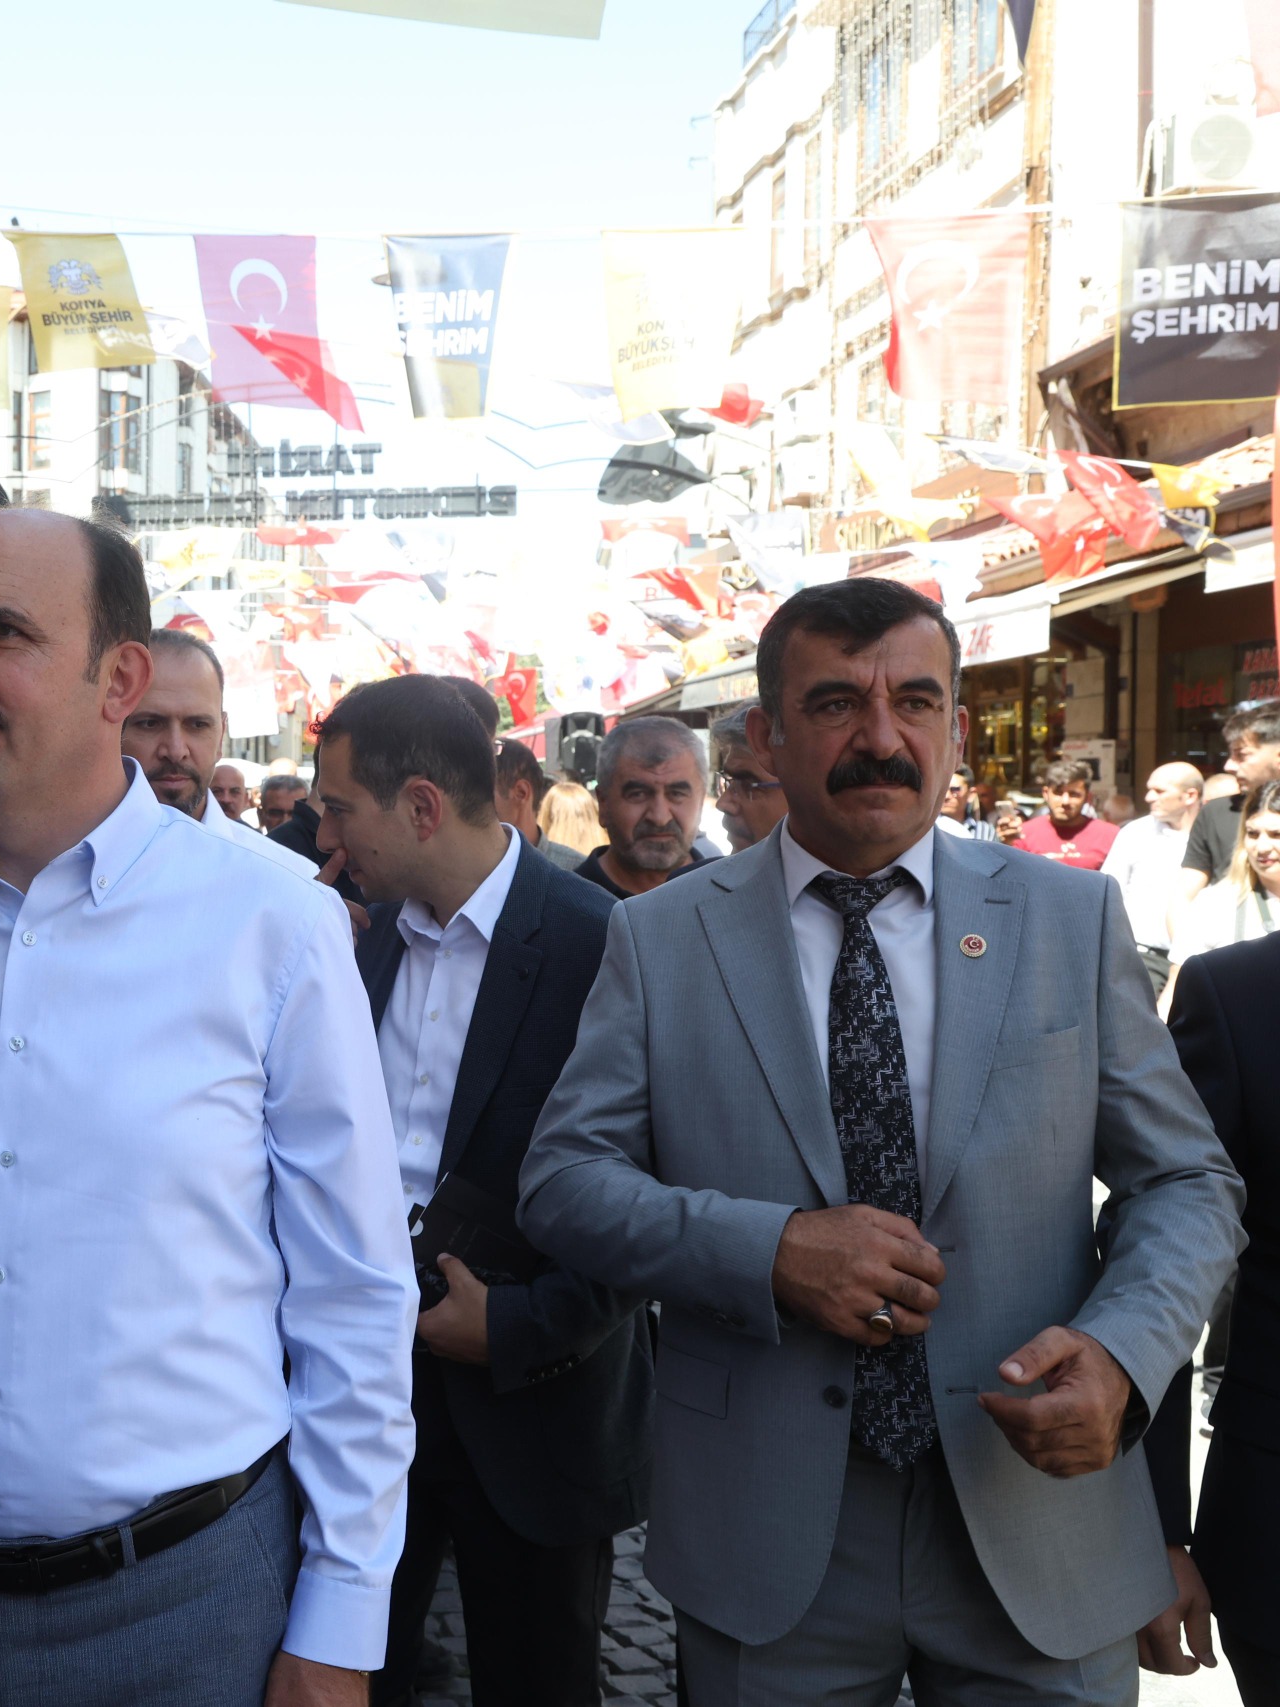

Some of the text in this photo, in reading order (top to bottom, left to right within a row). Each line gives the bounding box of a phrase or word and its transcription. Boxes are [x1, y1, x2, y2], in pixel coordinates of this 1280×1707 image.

[1132, 259, 1280, 300] BENİM
[59, 299, 106, 311] KONYA
[1131, 301, 1278, 343] ŞEHRİM
